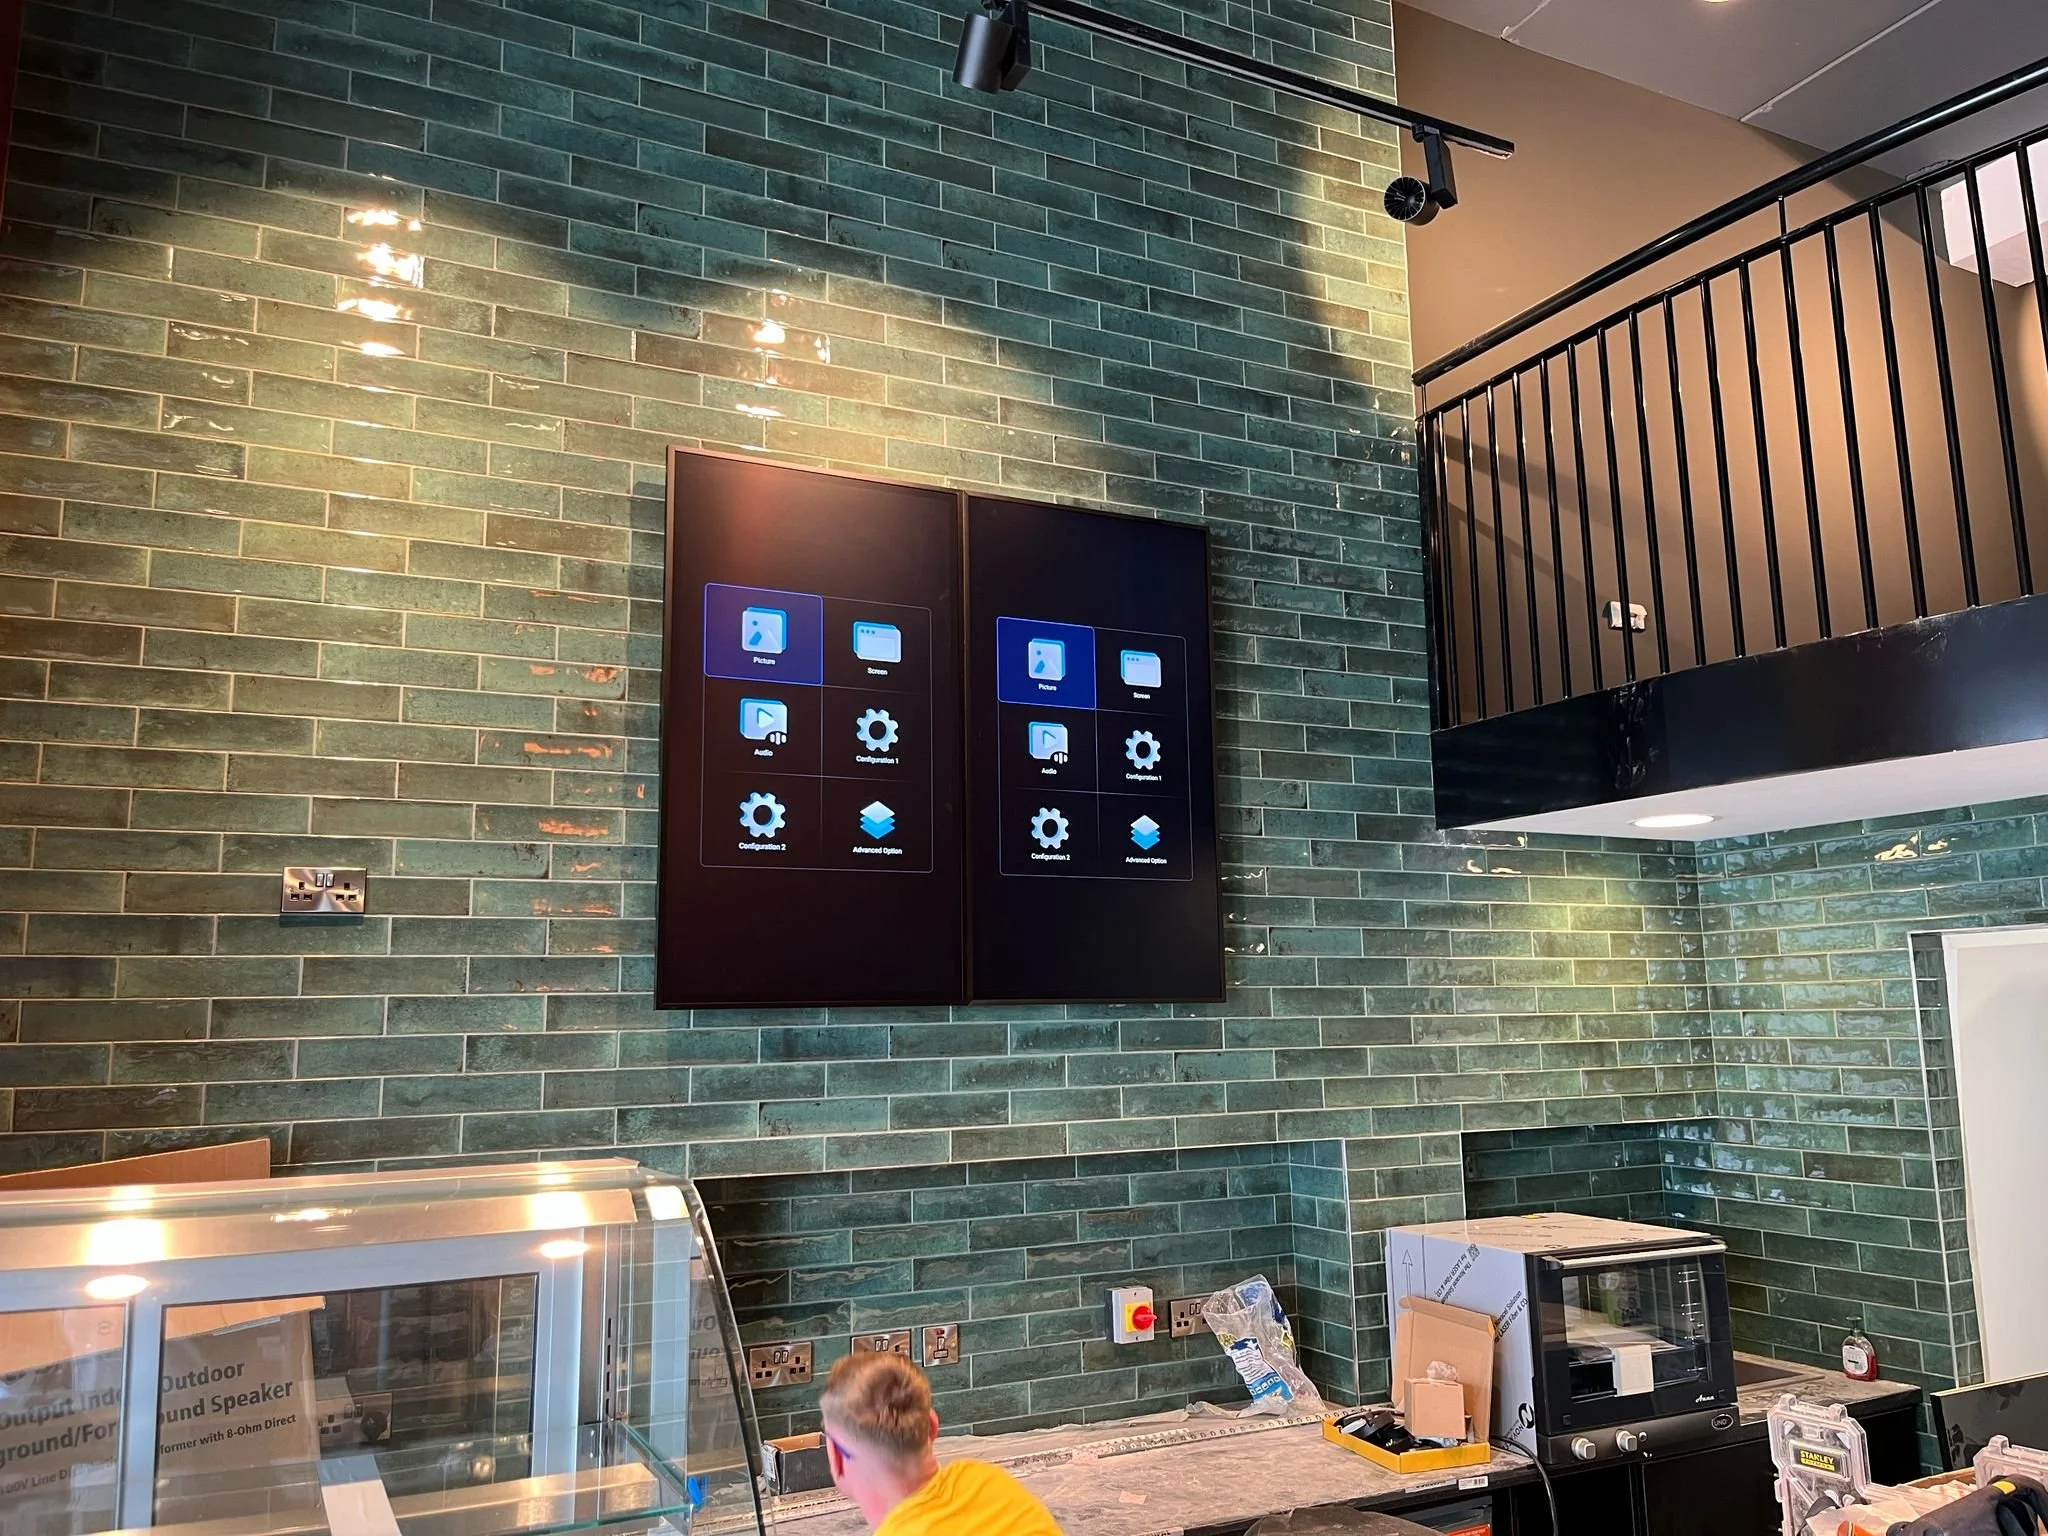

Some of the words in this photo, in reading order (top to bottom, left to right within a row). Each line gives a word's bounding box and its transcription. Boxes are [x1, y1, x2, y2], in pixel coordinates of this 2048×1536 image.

[753, 656, 776, 665] Picture
[867, 667, 888, 676] Screen
[1038, 683, 1057, 692] Picture
[1133, 692, 1151, 700] Screen
[754, 748, 773, 757] Audio
[856, 755, 894, 765] Configuration
[1041, 767, 1057, 775] Audio
[1125, 773, 1158, 781] Configuration
[739, 842, 780, 852] Configuration
[780, 843, 786, 851] 2
[853, 846, 882, 854] Advanced
[883, 847, 903, 856] Option
[1031, 852, 1065, 861] Configuration
[1125, 856, 1150, 864] Advanced
[1150, 857, 1168, 865] Option
[161, 1362, 245, 1393] Outdoor
[81, 1386, 122, 1410] Ind
[211, 1381, 293, 1415] Speaker
[200, 1431, 224, 1445] with
[226, 1422, 262, 1439] 8-Ohm
[264, 1414, 296, 1430] Direct
[1800, 1450, 1834, 1465] STANLEY
[31, 1473, 57, 1487] Line
